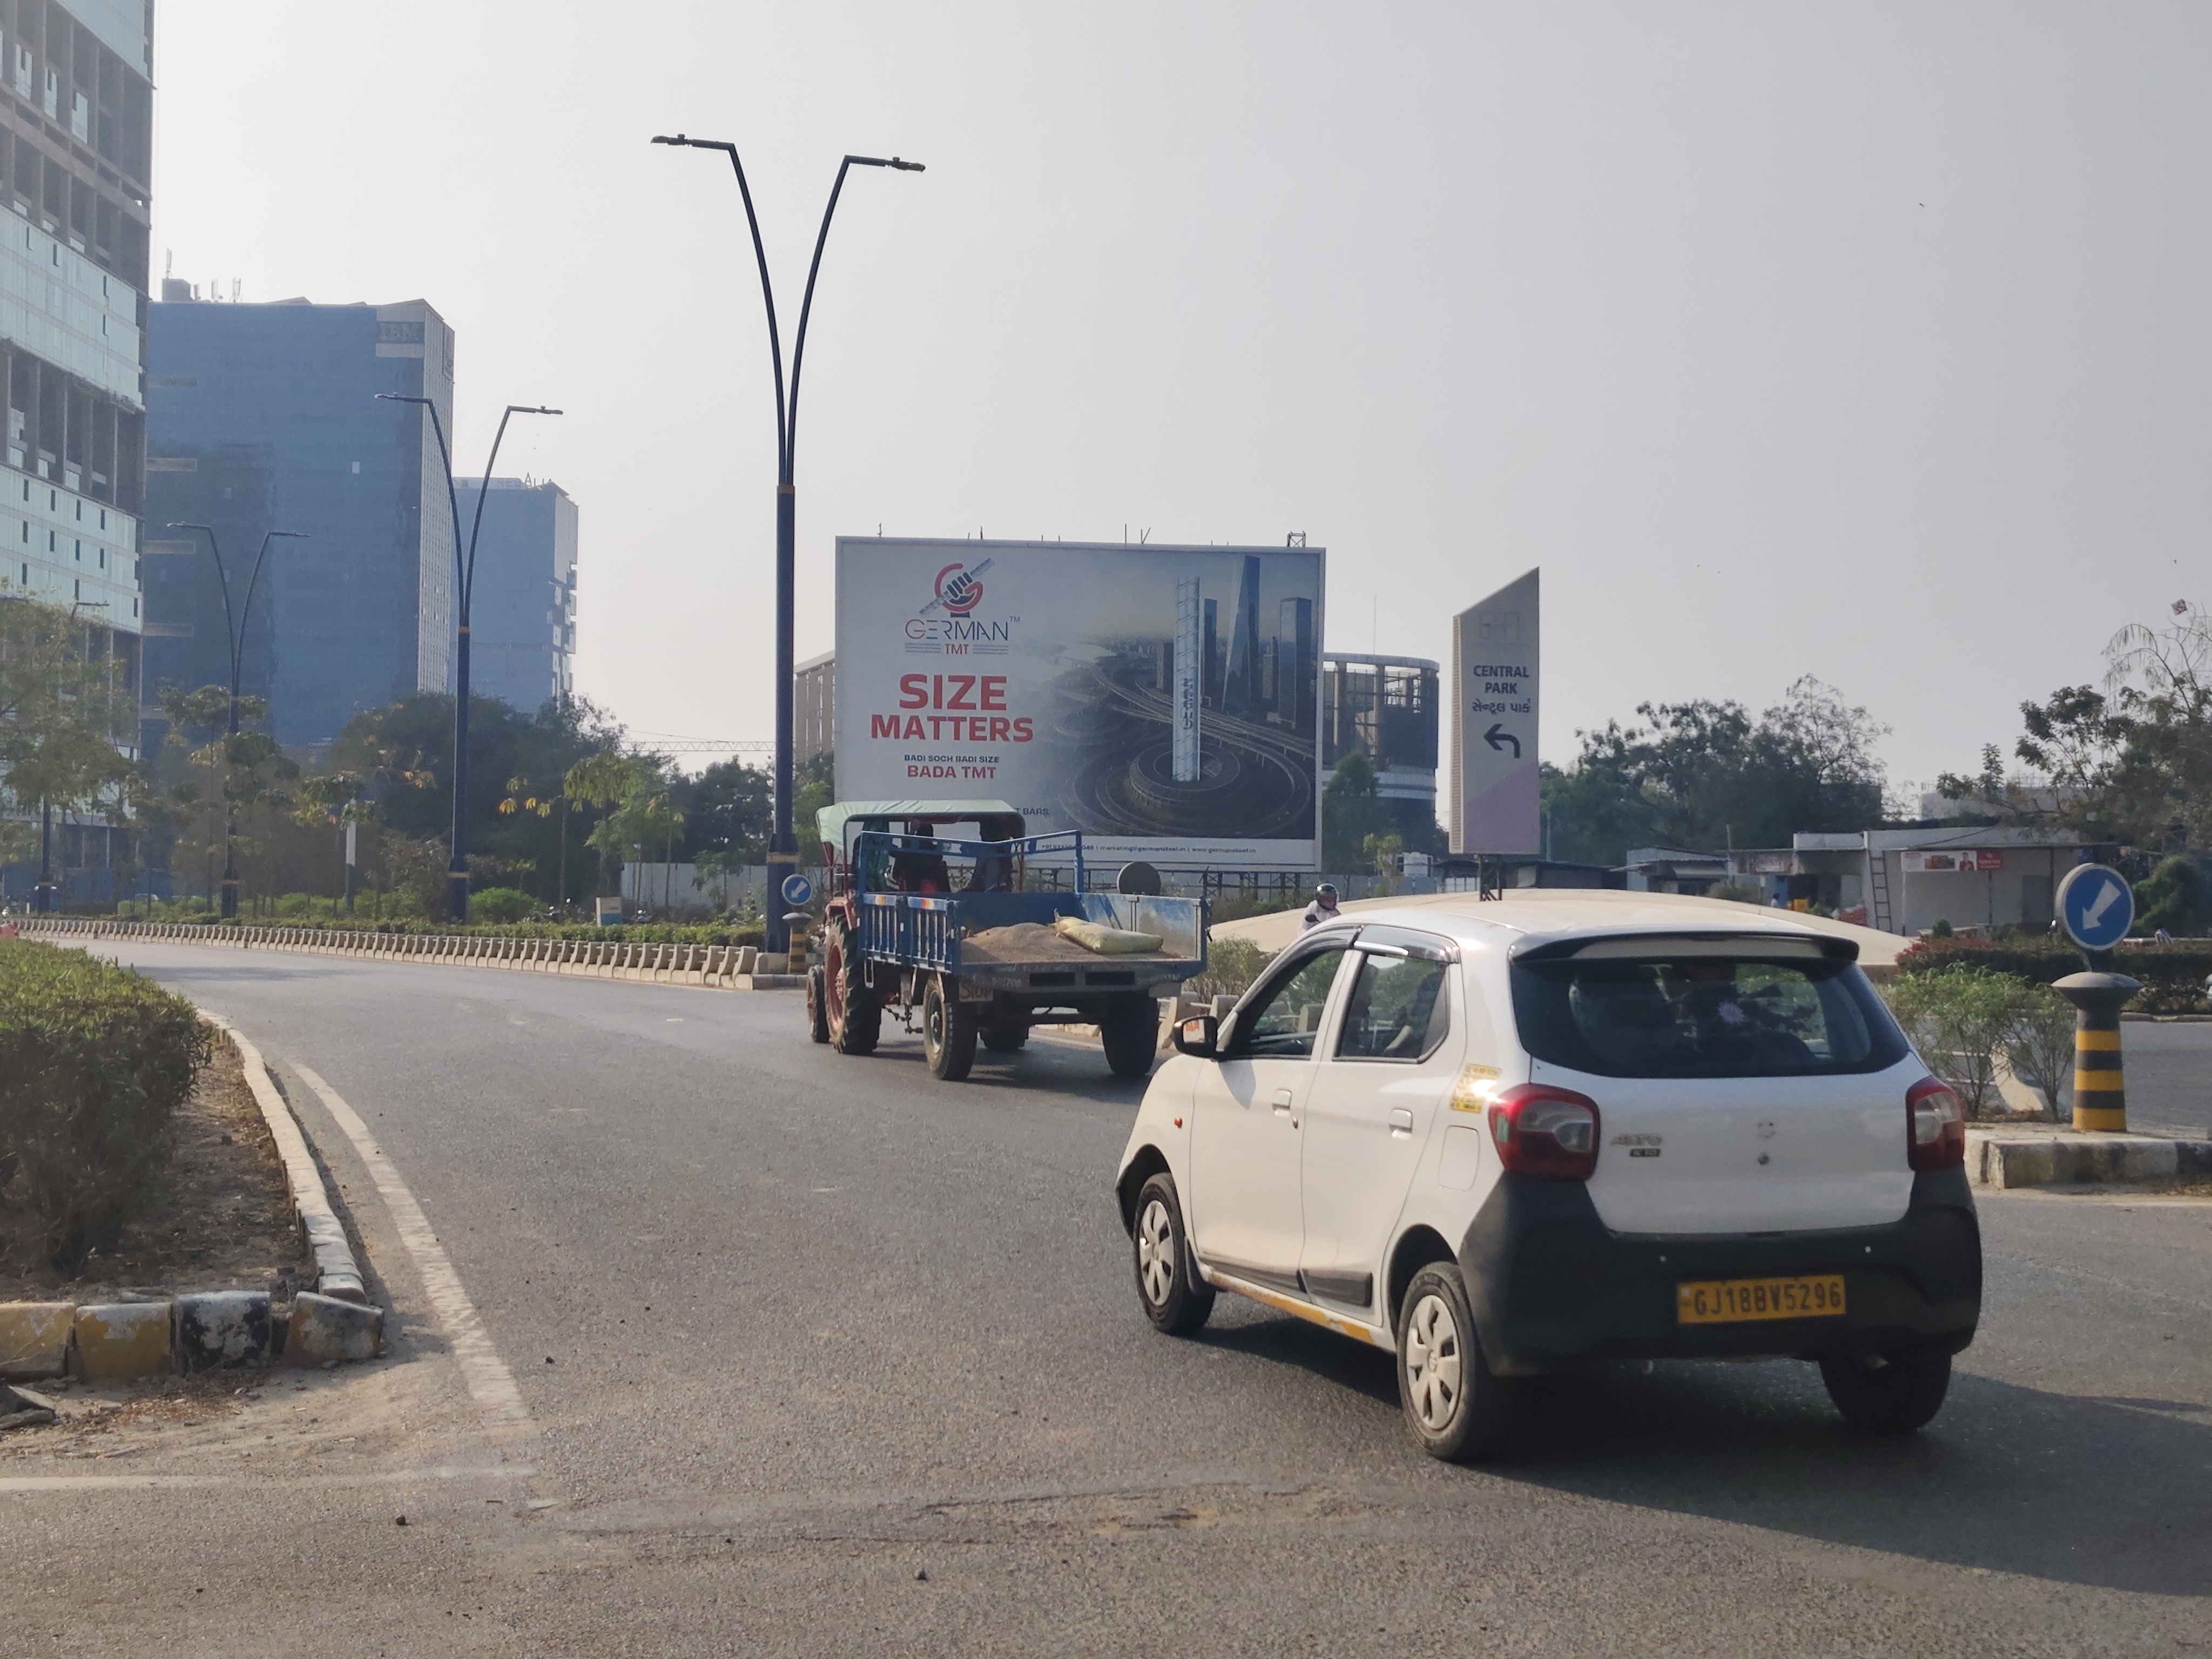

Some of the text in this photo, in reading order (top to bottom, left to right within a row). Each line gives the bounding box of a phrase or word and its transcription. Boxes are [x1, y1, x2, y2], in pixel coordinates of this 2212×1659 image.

[905, 619, 1008, 641] GERMAN
[945, 644, 969, 655] TMT
[1473, 665, 1529, 678] CENTRAL
[899, 673, 1007, 711] SIZE
[1485, 682, 1517, 694] PARK
[871, 714, 1034, 743] MATTERS
[908, 765, 996, 779] BADA TMT
